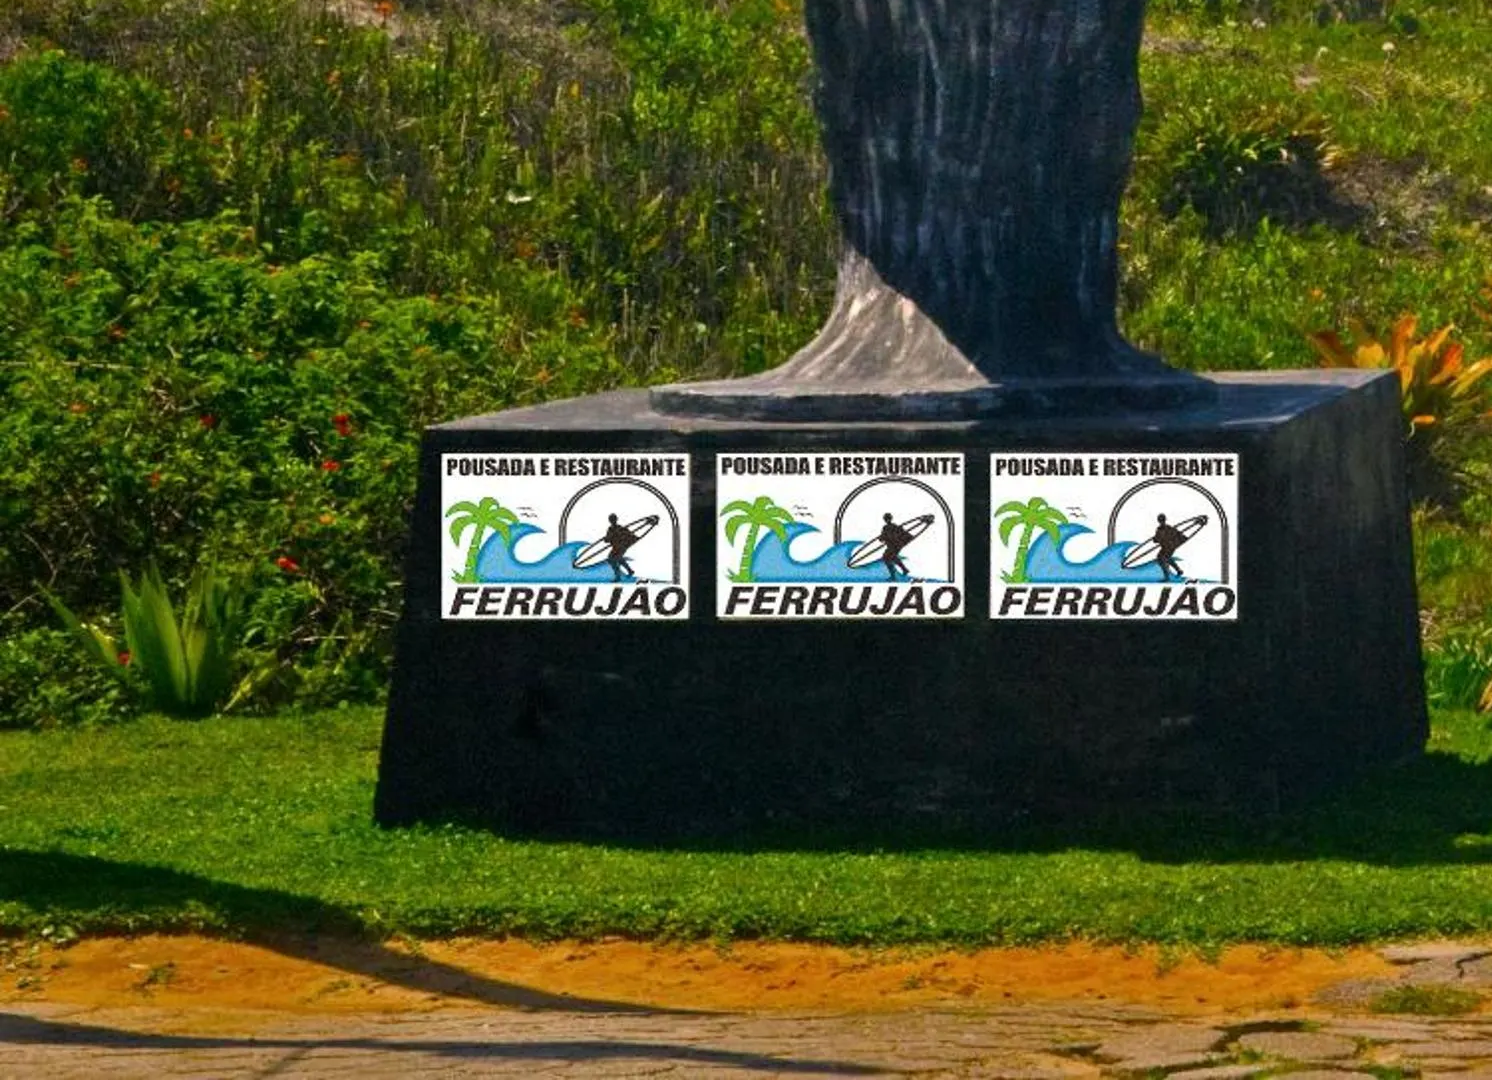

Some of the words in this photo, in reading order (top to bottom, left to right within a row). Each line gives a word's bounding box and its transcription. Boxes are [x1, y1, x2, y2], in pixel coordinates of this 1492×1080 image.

[446, 457, 535, 476] POUSADA
[540, 457, 549, 476] E
[554, 457, 686, 476] RESTAURANTE
[721, 457, 810, 477] POUSADA
[814, 457, 824, 477] E
[828, 457, 961, 477] RESTAURANTE
[995, 457, 1084, 476] POUSADA
[1088, 457, 1098, 476] E
[1103, 457, 1235, 476] RESTAURANTE
[449, 581, 686, 616] FERRUJÃO
[724, 579, 961, 615] FERRUJÃO
[998, 581, 1235, 616] FERRUJÃO
